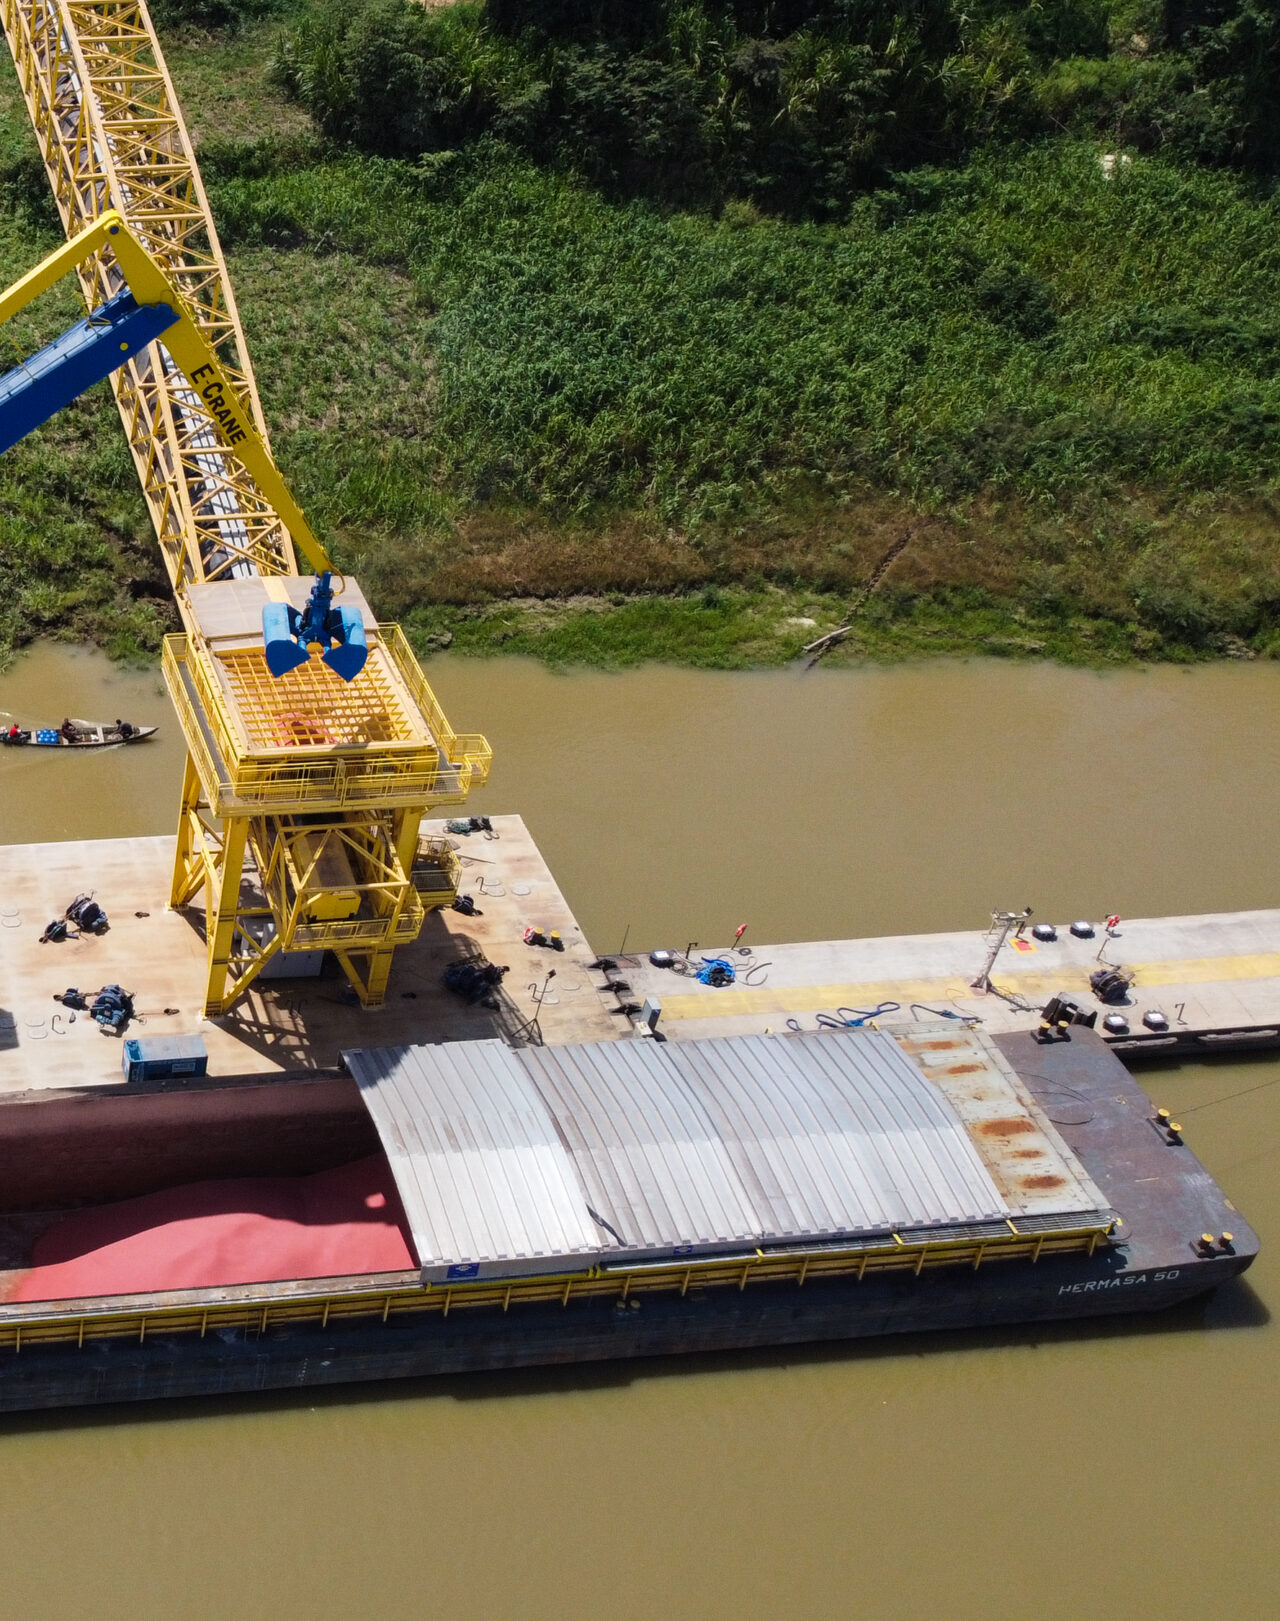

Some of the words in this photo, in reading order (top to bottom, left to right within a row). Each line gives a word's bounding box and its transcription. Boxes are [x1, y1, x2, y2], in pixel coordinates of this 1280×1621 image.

[190, 363, 247, 445] E-CRANE
[1058, 1274, 1148, 1295] HERMASA
[1154, 1269, 1180, 1281] 50
